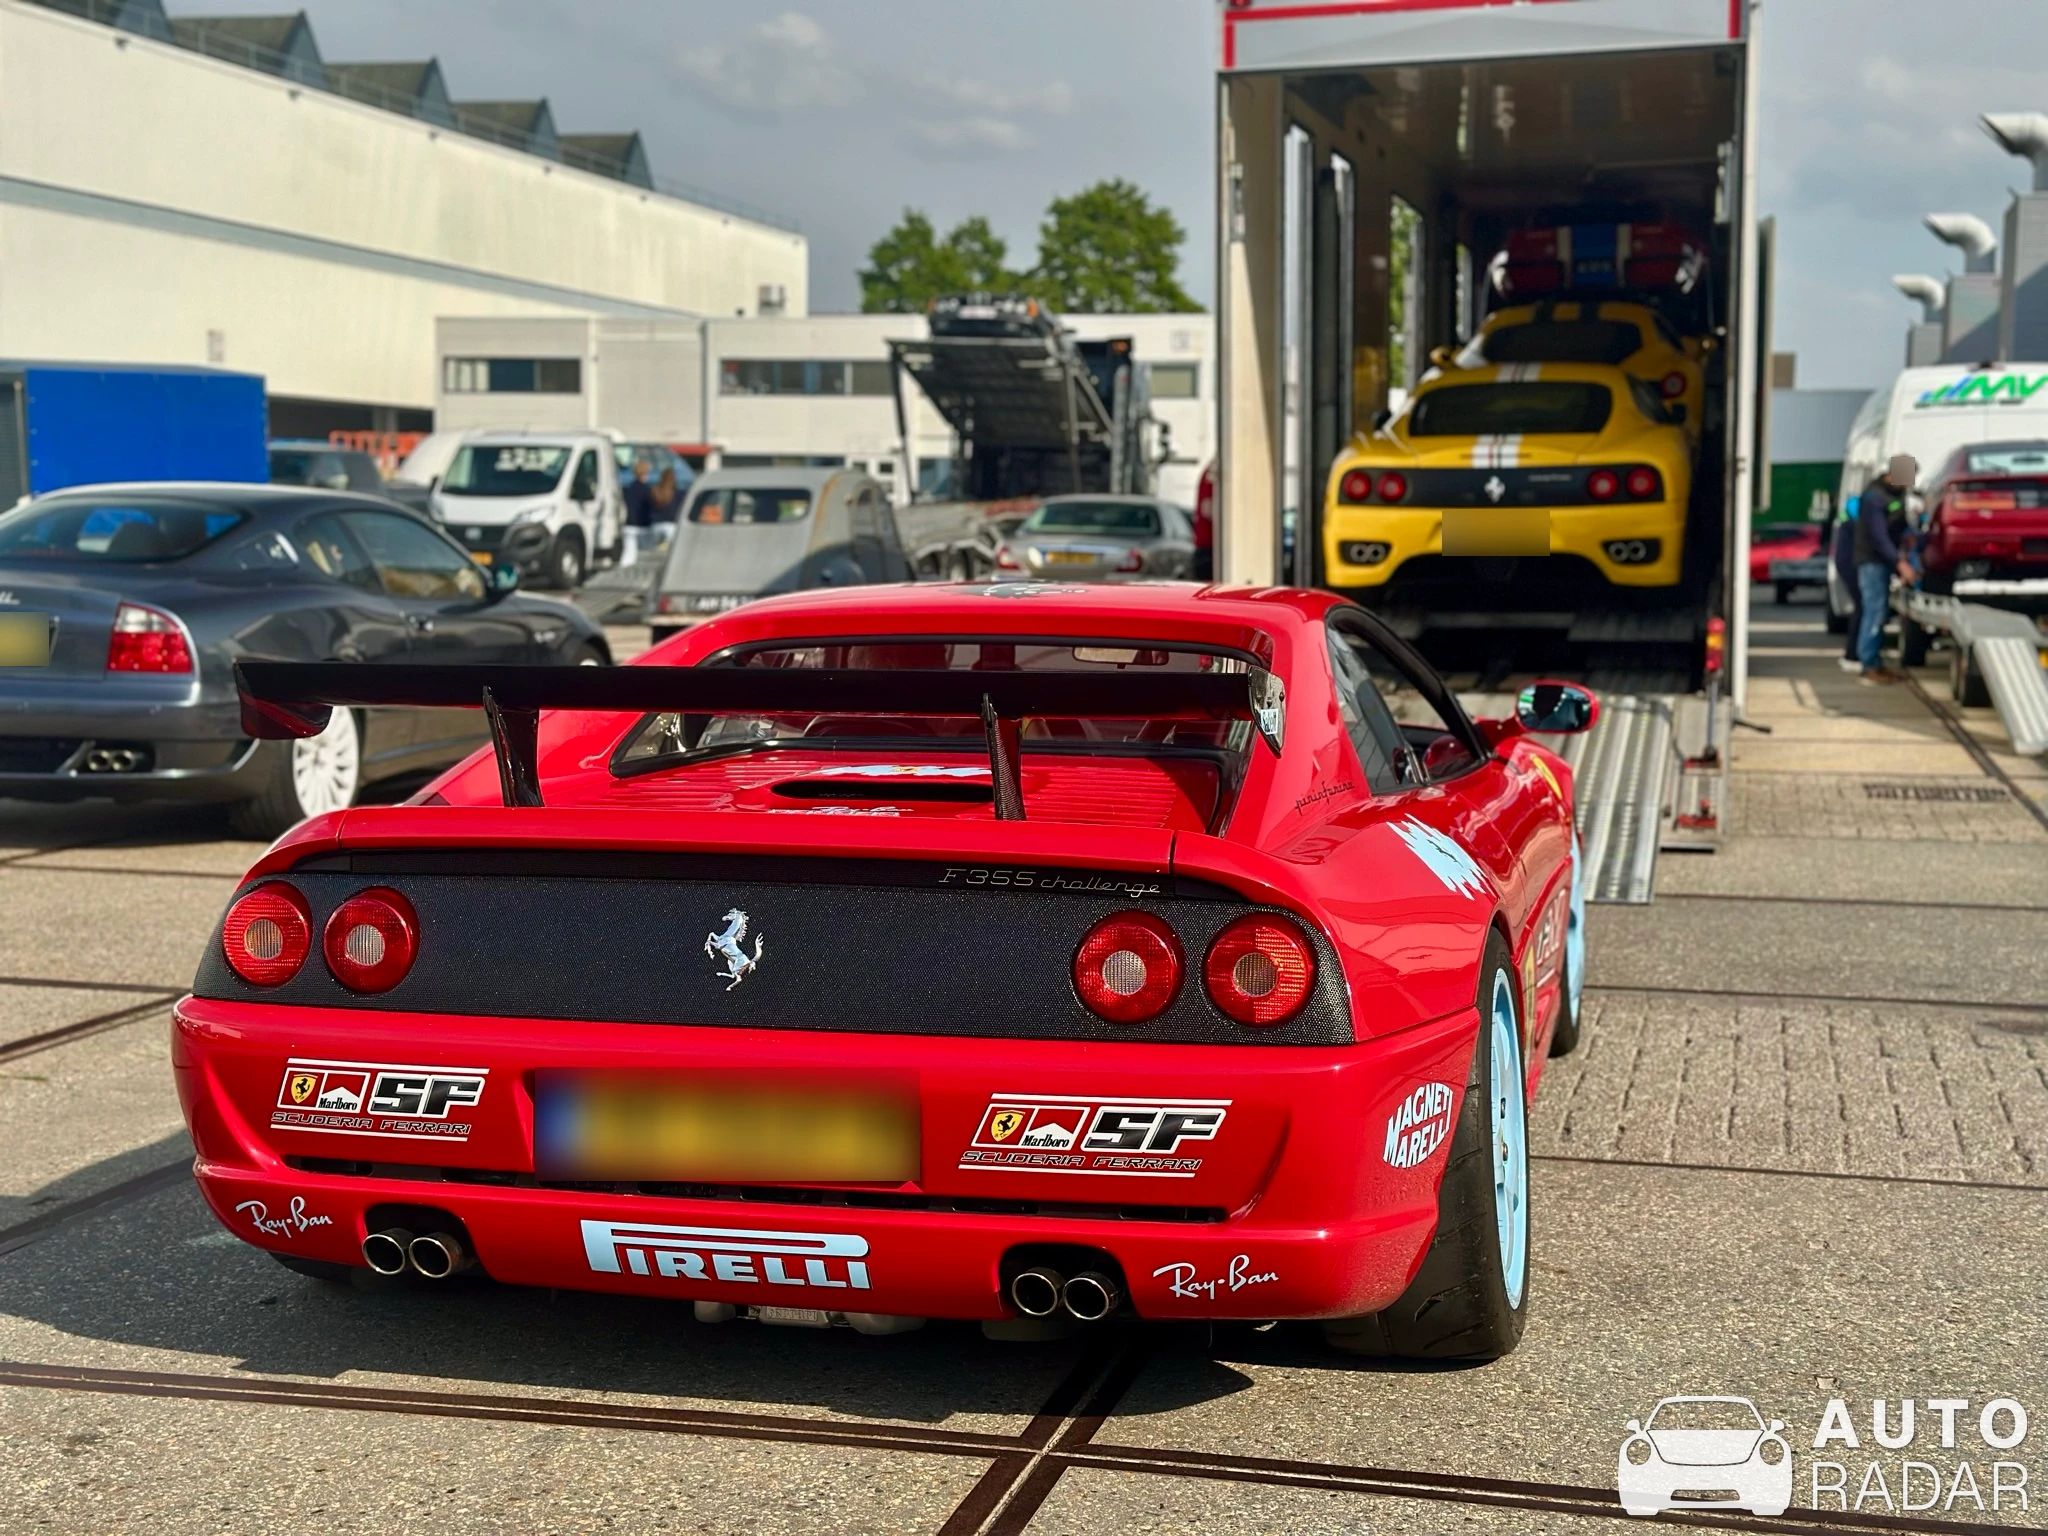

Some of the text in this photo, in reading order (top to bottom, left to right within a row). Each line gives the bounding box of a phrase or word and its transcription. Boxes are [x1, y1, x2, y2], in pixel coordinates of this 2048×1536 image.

[938, 868, 1161, 898] F355 challenge
[318, 1097, 358, 1111] Marlboro
[367, 1072, 485, 1118] SF
[271, 1112, 472, 1134] SCUDERIA FERRARI
[1021, 1134, 1070, 1148] Marlboro
[1080, 1106, 1227, 1154] SF
[960, 1151, 1203, 1171] SCUDERIA FERRARI
[236, 1196, 333, 1238] Ray-Ban
[580, 1219, 872, 1290] PIRELLI
[1153, 1254, 1279, 1300] Ray-Ban
